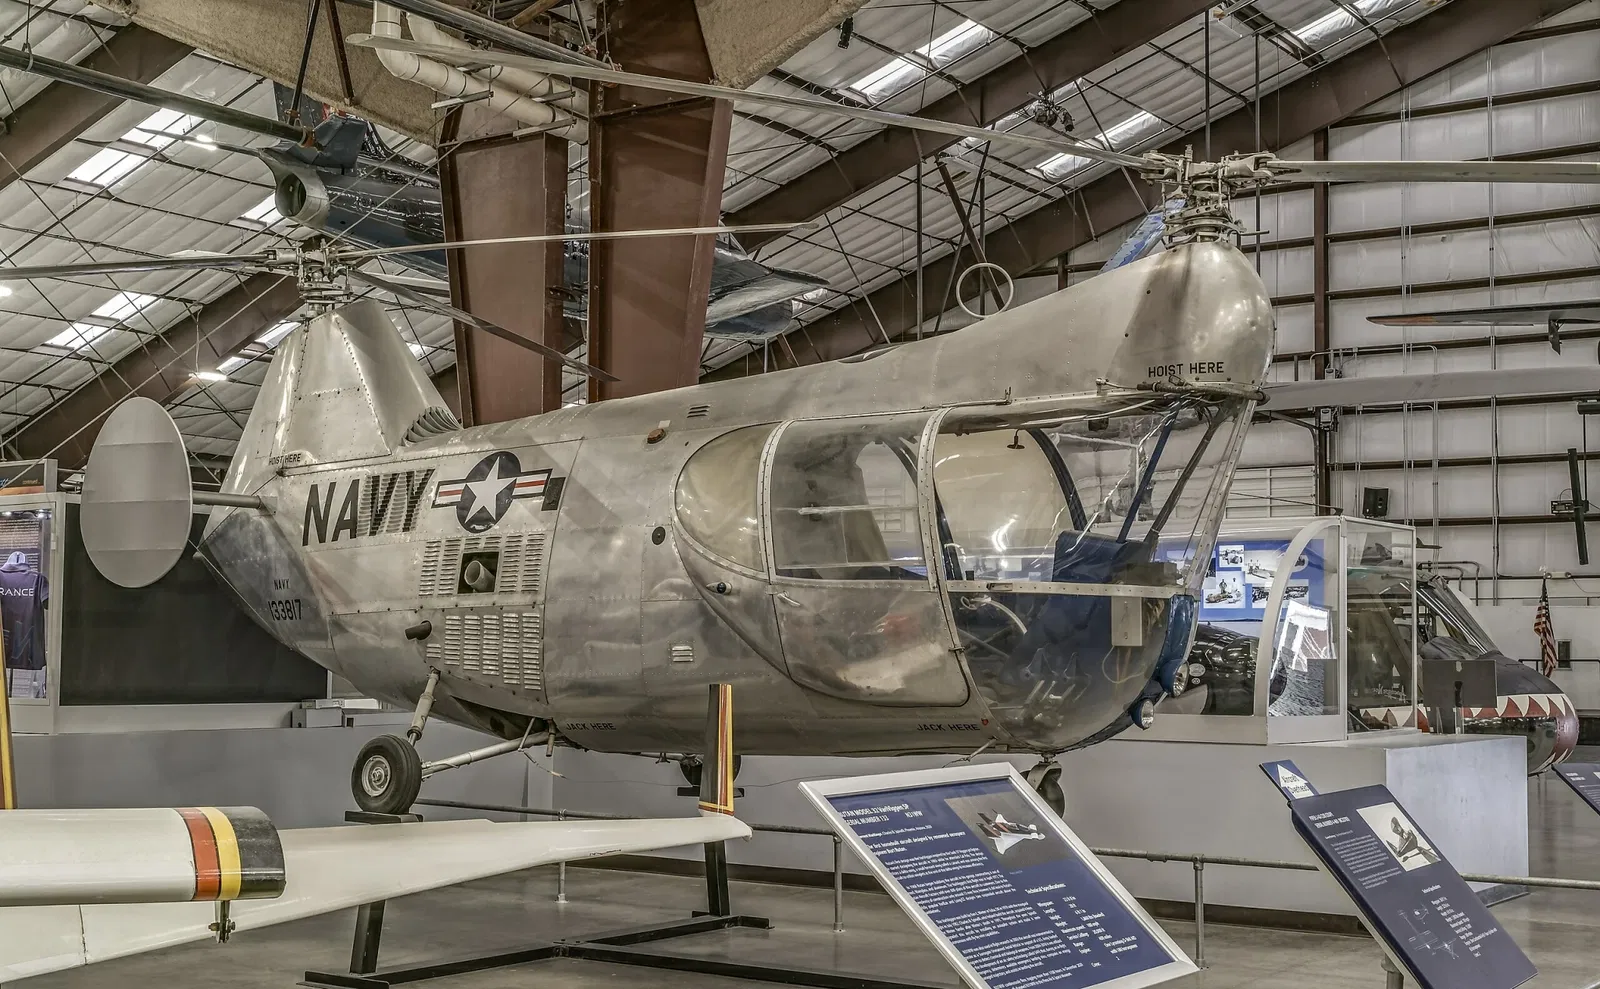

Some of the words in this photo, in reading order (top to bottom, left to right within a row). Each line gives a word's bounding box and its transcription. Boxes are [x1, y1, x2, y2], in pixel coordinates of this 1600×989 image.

[1148, 363, 1184, 378] HOIST
[1189, 361, 1224, 374] HERE
[285, 453, 301, 463] HERE
[302, 469, 435, 546] NAVY
[274, 579, 290, 590] NAVY
[267, 599, 302, 621] 133817
[566, 723, 590, 731] JACK
[590, 722, 616, 731] HERE
[947, 723, 981, 731] HERE
